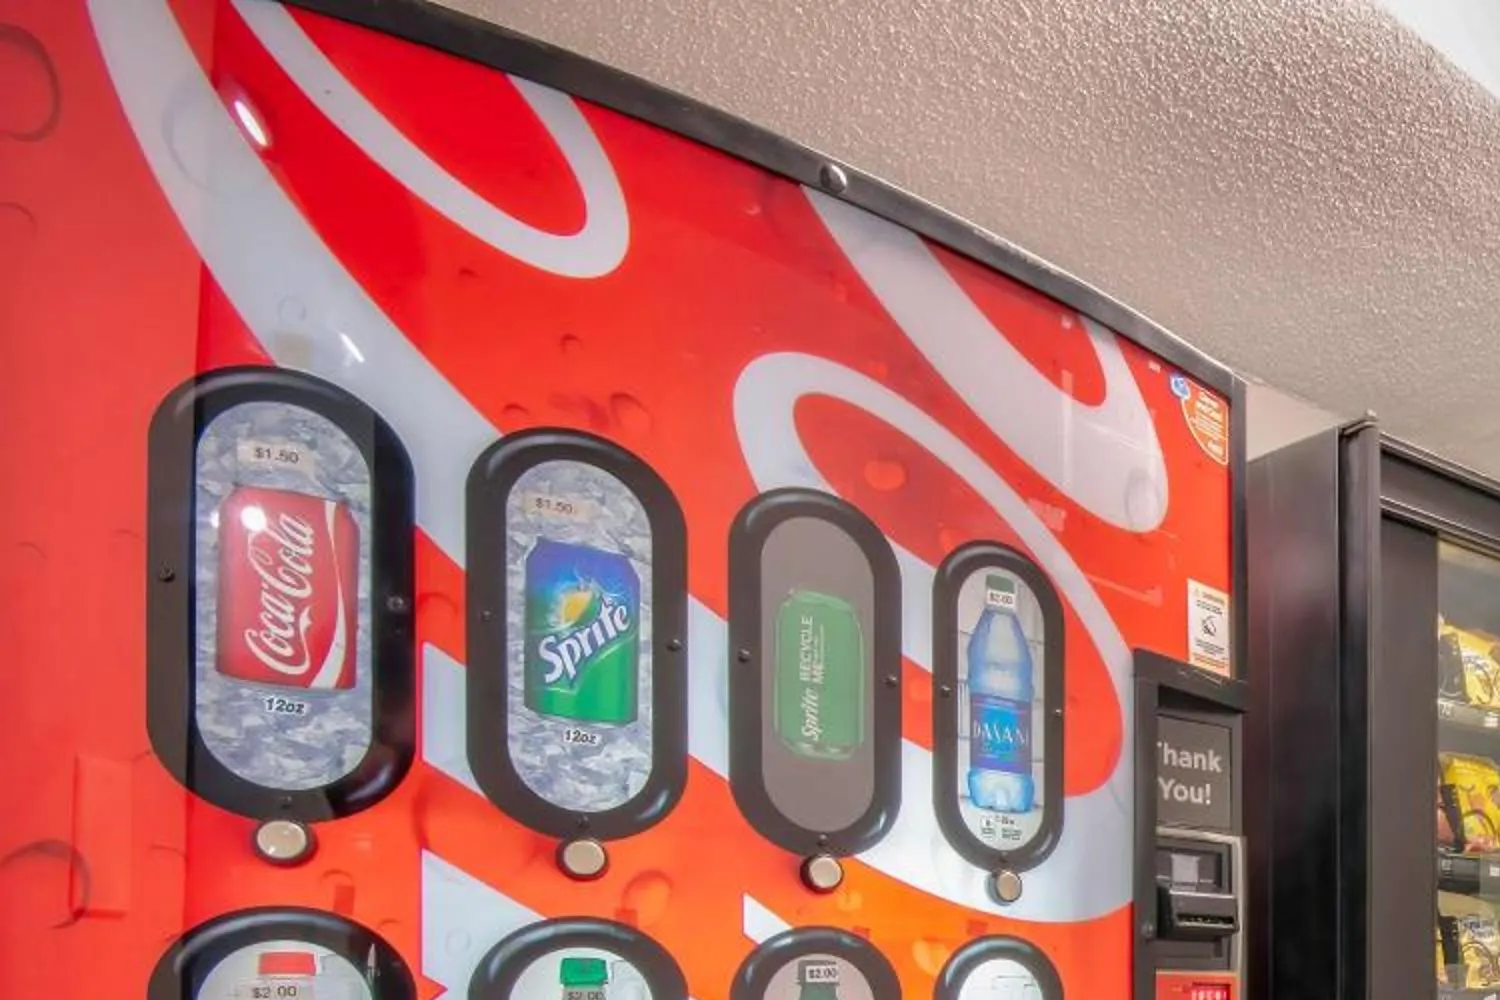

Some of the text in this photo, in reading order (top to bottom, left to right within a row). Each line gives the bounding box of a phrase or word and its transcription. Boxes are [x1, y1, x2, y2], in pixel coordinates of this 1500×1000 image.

[254, 446, 300, 465] $1.50
[538, 597, 632, 683] Sprite
[800, 615, 814, 682] RECYCLE
[266, 697, 305, 714] 12oz
[799, 686, 823, 742] Sprite
[1156, 741, 1223, 773] hank
[1158, 776, 1211, 805] You!
[808, 967, 838, 981] $2.00
